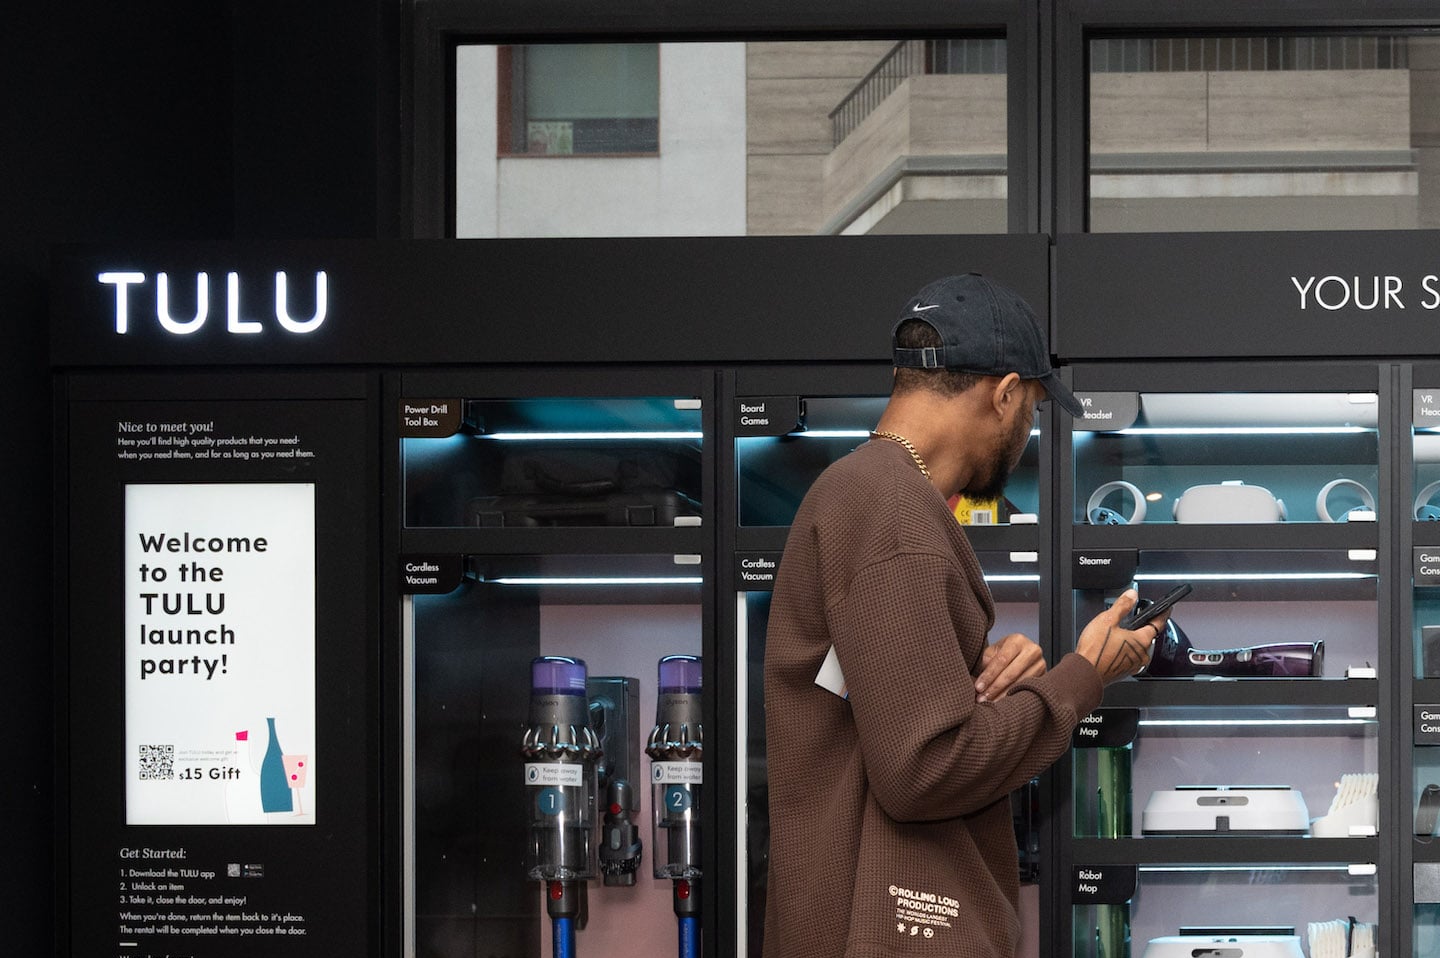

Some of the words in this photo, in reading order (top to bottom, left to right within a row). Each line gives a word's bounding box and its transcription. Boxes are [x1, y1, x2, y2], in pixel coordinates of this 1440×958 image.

[1291, 275, 1405, 311] YOUR
[97, 270, 328, 335] TULU
[1079, 397, 1093, 407] VR
[1420, 394, 1433, 404] VR
[404, 404, 430, 415] Power
[430, 403, 448, 415] Drill
[740, 402, 765, 413] Board
[404, 416, 422, 427] Tool
[423, 417, 439, 427] Box
[740, 415, 769, 426] Games
[119, 421, 143, 433] Nice
[146, 422, 157, 433] to
[160, 422, 187, 433] meet
[190, 421, 213, 436] you!
[118, 437, 135, 446] Here
[137, 436, 156, 448] you'll
[158, 436, 172, 446] find
[174, 435, 189, 448] high
[191, 436, 215, 448] quality
[217, 435, 247, 447] products
[249, 435, 263, 445] that
[264, 438, 278, 447] you
[280, 435, 300, 445] need-
[138, 531, 268, 553] Welcome
[741, 558, 776, 569] Cordless
[1079, 555, 1112, 566] Steamer
[139, 563, 167, 583] to
[178, 561, 224, 583] the
[405, 561, 440, 573] Cordless
[405, 575, 438, 585] Vacuum
[741, 571, 773, 581] Vacuum
[139, 592, 225, 616] TULU
[140, 623, 235, 645] launch
[140, 653, 227, 681] party!
[1079, 713, 1103, 724] obot
[1079, 727, 1099, 738] Mop
[179, 767, 203, 781] $15
[208, 766, 241, 780] Gift
[548, 794, 555, 808] 1
[672, 792, 682, 807] 2
[120, 847, 139, 859] Get
[142, 847, 186, 859] Started:
[129, 868, 166, 878] Download
[167, 868, 178, 878] the
[180, 869, 198, 878] TULU
[200, 871, 215, 880] app
[1078, 869, 1103, 881] Robot
[120, 881, 127, 891] 2.
[132, 881, 156, 891] Unlock
[169, 882, 184, 891] item
[1078, 883, 1098, 895] Mop
[120, 895, 127, 904] 3.
[129, 894, 145, 905] Take
[156, 894, 174, 905] close
[175, 894, 186, 905] the
[188, 895, 206, 905] door,
[208, 895, 222, 905] and
[224, 895, 246, 907] enjoy!
[938, 895, 960, 908] LOUD
[897, 897, 959, 918] PRODUCTIONS
[120, 911, 142, 921] When
[143, 912, 166, 923] you're
[168, 911, 188, 922] done,
[190, 913, 211, 921] return
[213, 911, 224, 922] the
[226, 913, 240, 921] item
[242, 911, 260, 922] back
[261, 913, 268, 922] to
[271, 913, 281, 922] it's
[283, 912, 304, 924] place.
[120, 924, 132, 934] The
[134, 924, 154, 934] rental
[156, 924, 168, 934] will
[170, 924, 180, 935] be
[181, 925, 218, 937] completed
[219, 925, 238, 935] when
[240, 927, 254, 937] you
[256, 925, 274, 935] close
[276, 925, 286, 935] the
[288, 925, 306, 935] door.
